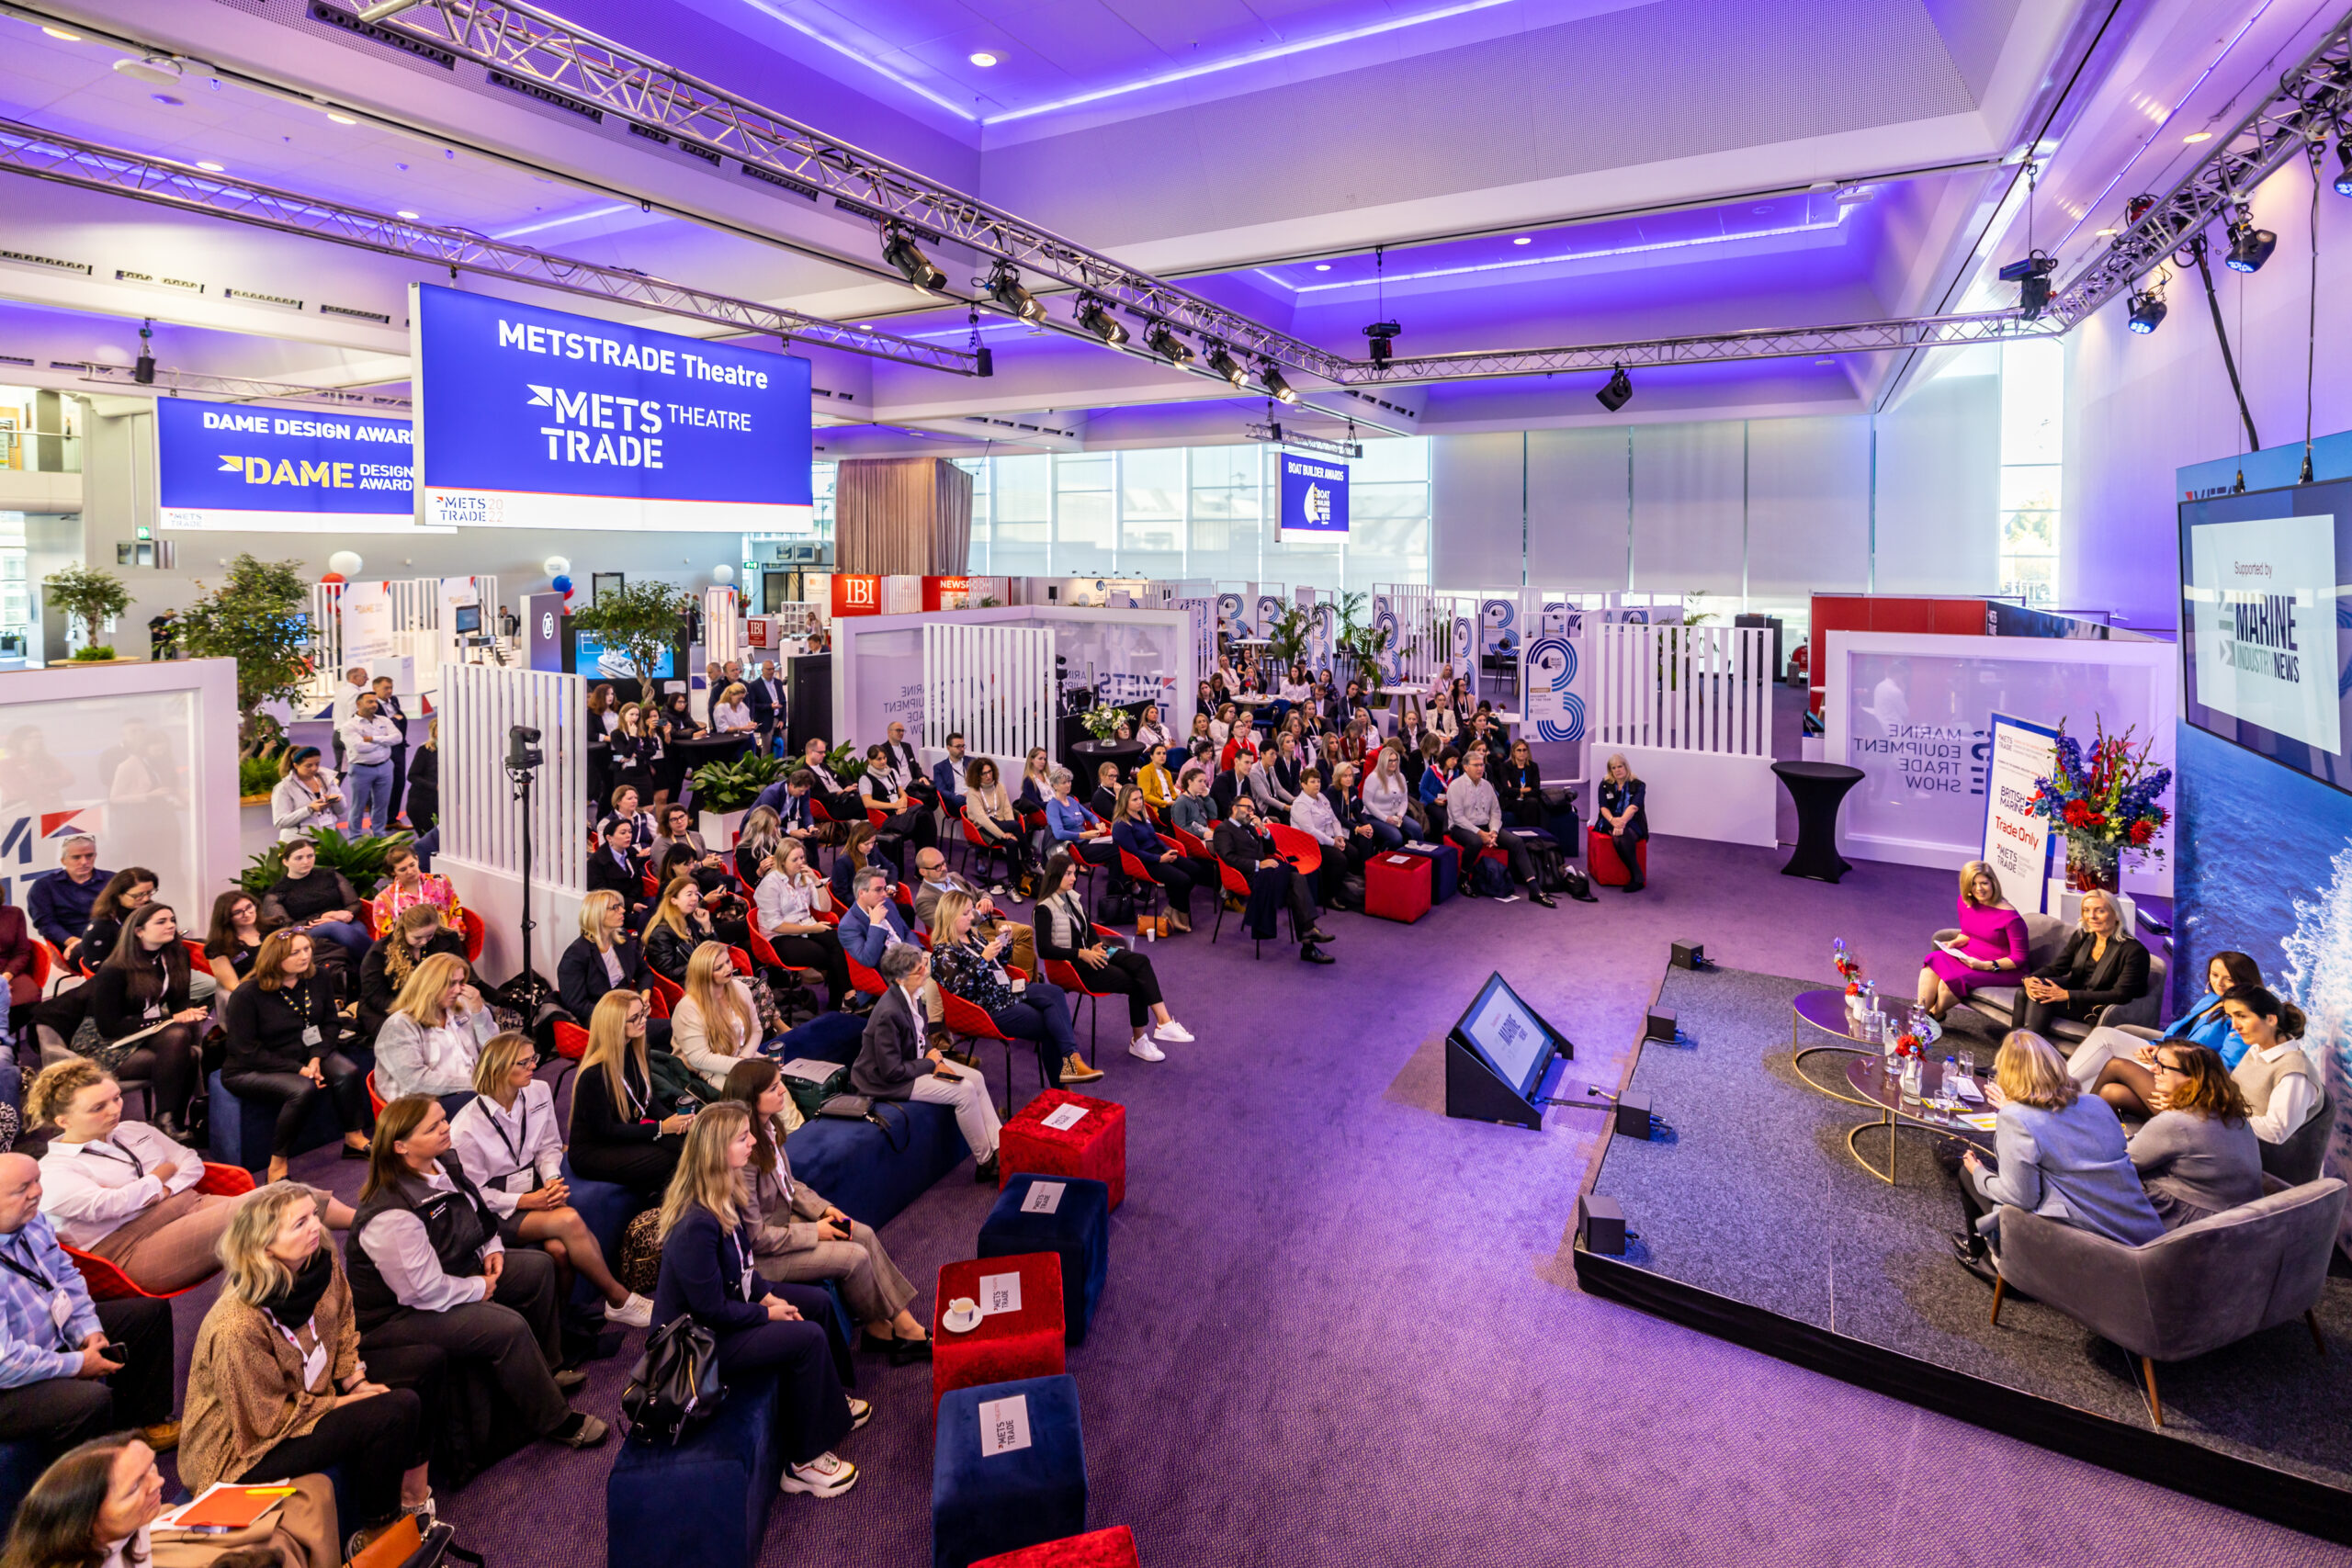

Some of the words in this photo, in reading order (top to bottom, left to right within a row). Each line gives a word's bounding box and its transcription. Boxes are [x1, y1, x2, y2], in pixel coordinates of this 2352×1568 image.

[498, 319, 676, 376] METSTRADE
[681, 353, 769, 389] Theatre
[554, 387, 663, 434] METS
[666, 403, 752, 432] THEATRE
[202, 412, 269, 434] DAME
[274, 418, 351, 440] DESIGN
[355, 425, 414, 445] AWAR
[540, 426, 663, 469] TRADE
[244, 456, 355, 489] DAME
[359, 463, 414, 478] DESIGN
[1287, 461, 1303, 475] BOAT
[1302, 464, 1324, 479] BUILDER
[1324, 468, 1344, 481] AWARDS
[445, 496, 486, 509] METS
[488, 498, 503, 510] 20
[440, 510, 487, 522] TRADE
[488, 511, 503, 522] 22
[2234, 560, 2264, 578] Supported
[2265, 562, 2272, 579] by
[845, 579, 875, 604] IBI
[750, 622, 763, 635] IBI
[2235, 591, 2298, 651] MARINE
[2000, 785, 2026, 806] BRITISH
[1999, 796, 2025, 817] MARINE
[1996, 816, 2018, 838] Trade
[2018, 827, 2040, 852] Only
[1997, 854, 2017, 874] TRADE
[2000, 845, 2018, 863] METS
[1498, 1013, 1521, 1047] MARINE
[993, 1291, 1001, 1308] METS
[1001, 1290, 1009, 1309] TRADE
[996, 1421, 1006, 1445] METS
[1005, 1419, 1015, 1445] TRADE
